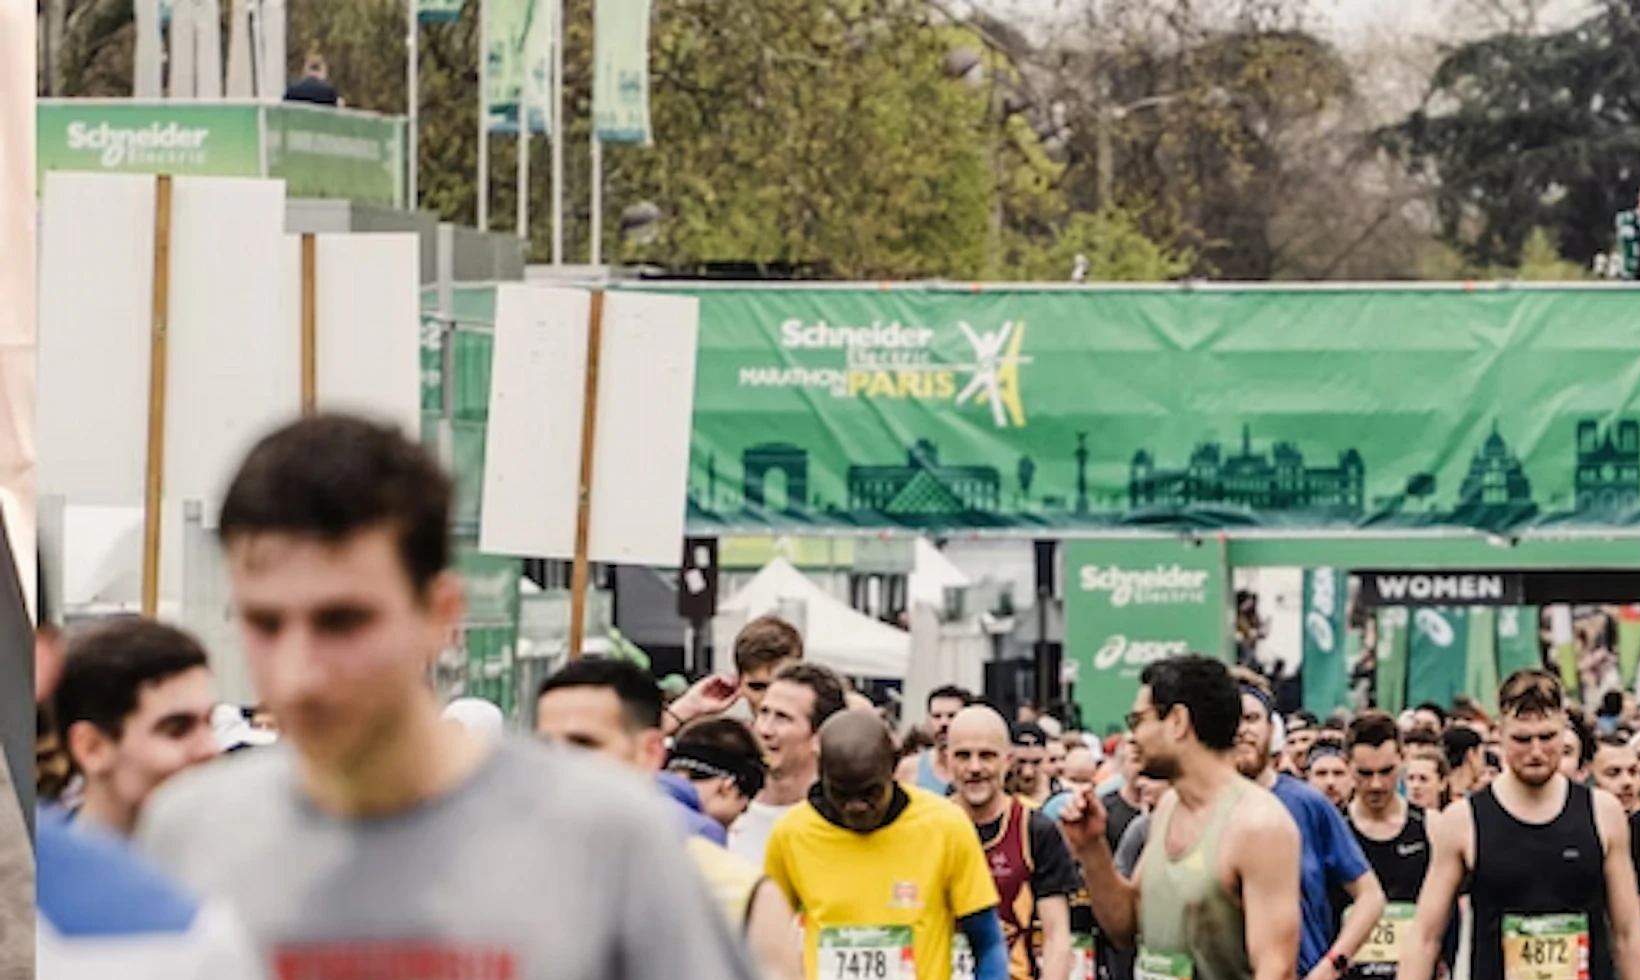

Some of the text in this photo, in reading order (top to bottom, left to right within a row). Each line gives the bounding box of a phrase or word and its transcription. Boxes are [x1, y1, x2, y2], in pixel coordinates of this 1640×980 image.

[67, 121, 209, 166] Schneider
[781, 318, 933, 348] Schneider
[739, 368, 848, 388] MARATHON
[848, 370, 957, 398] PARIS
[1080, 564, 1208, 607] Schneider
[1376, 574, 1502, 599] WOMEN
[835, 950, 886, 980] 7478
[1520, 937, 1568, 965] 4872
